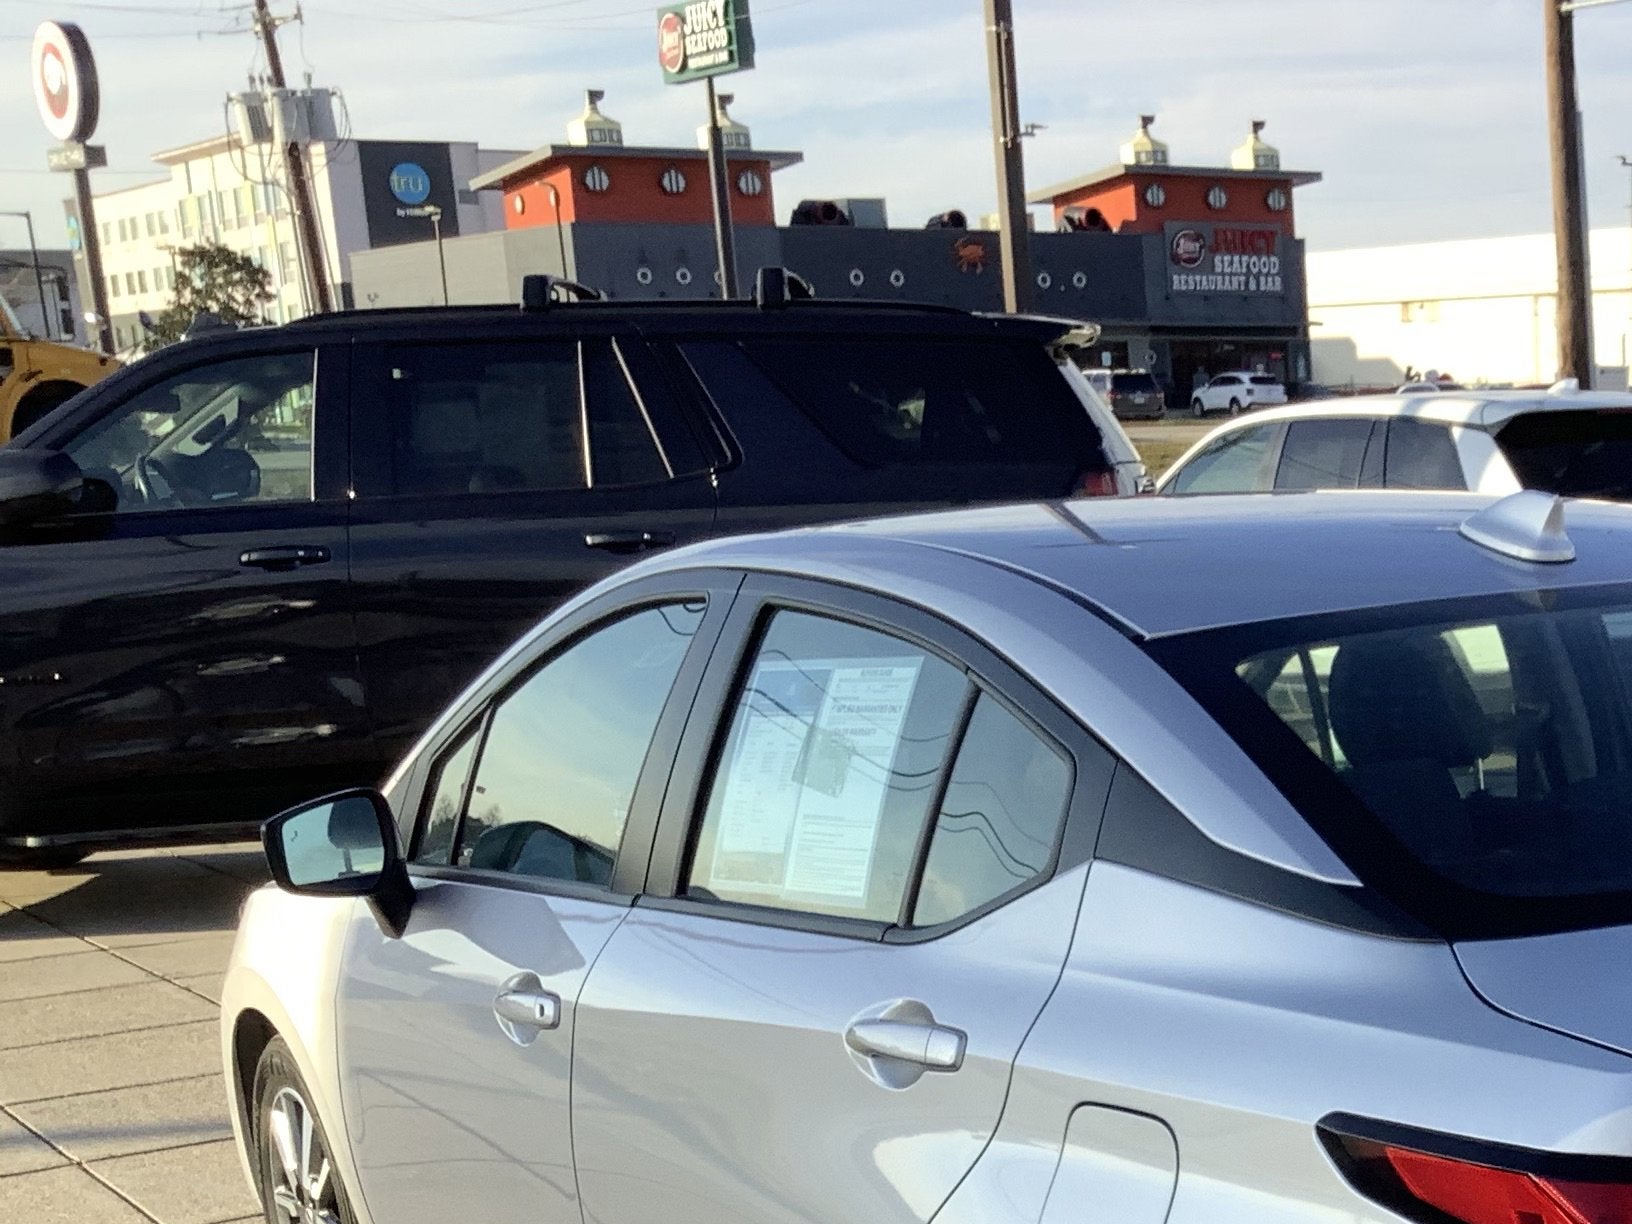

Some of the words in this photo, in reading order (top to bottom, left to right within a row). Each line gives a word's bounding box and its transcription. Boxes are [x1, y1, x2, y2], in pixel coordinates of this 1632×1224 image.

[683, 0, 725, 35] JUICY
[685, 27, 728, 56] SEAFOOD
[391, 168, 423, 193] tru
[1209, 230, 1277, 255] JUICY
[1215, 255, 1279, 274] SEAFOOD
[1172, 275, 1246, 291] RESTAURANT
[1248, 275, 1257, 291] &
[1260, 276, 1282, 291] BAR
